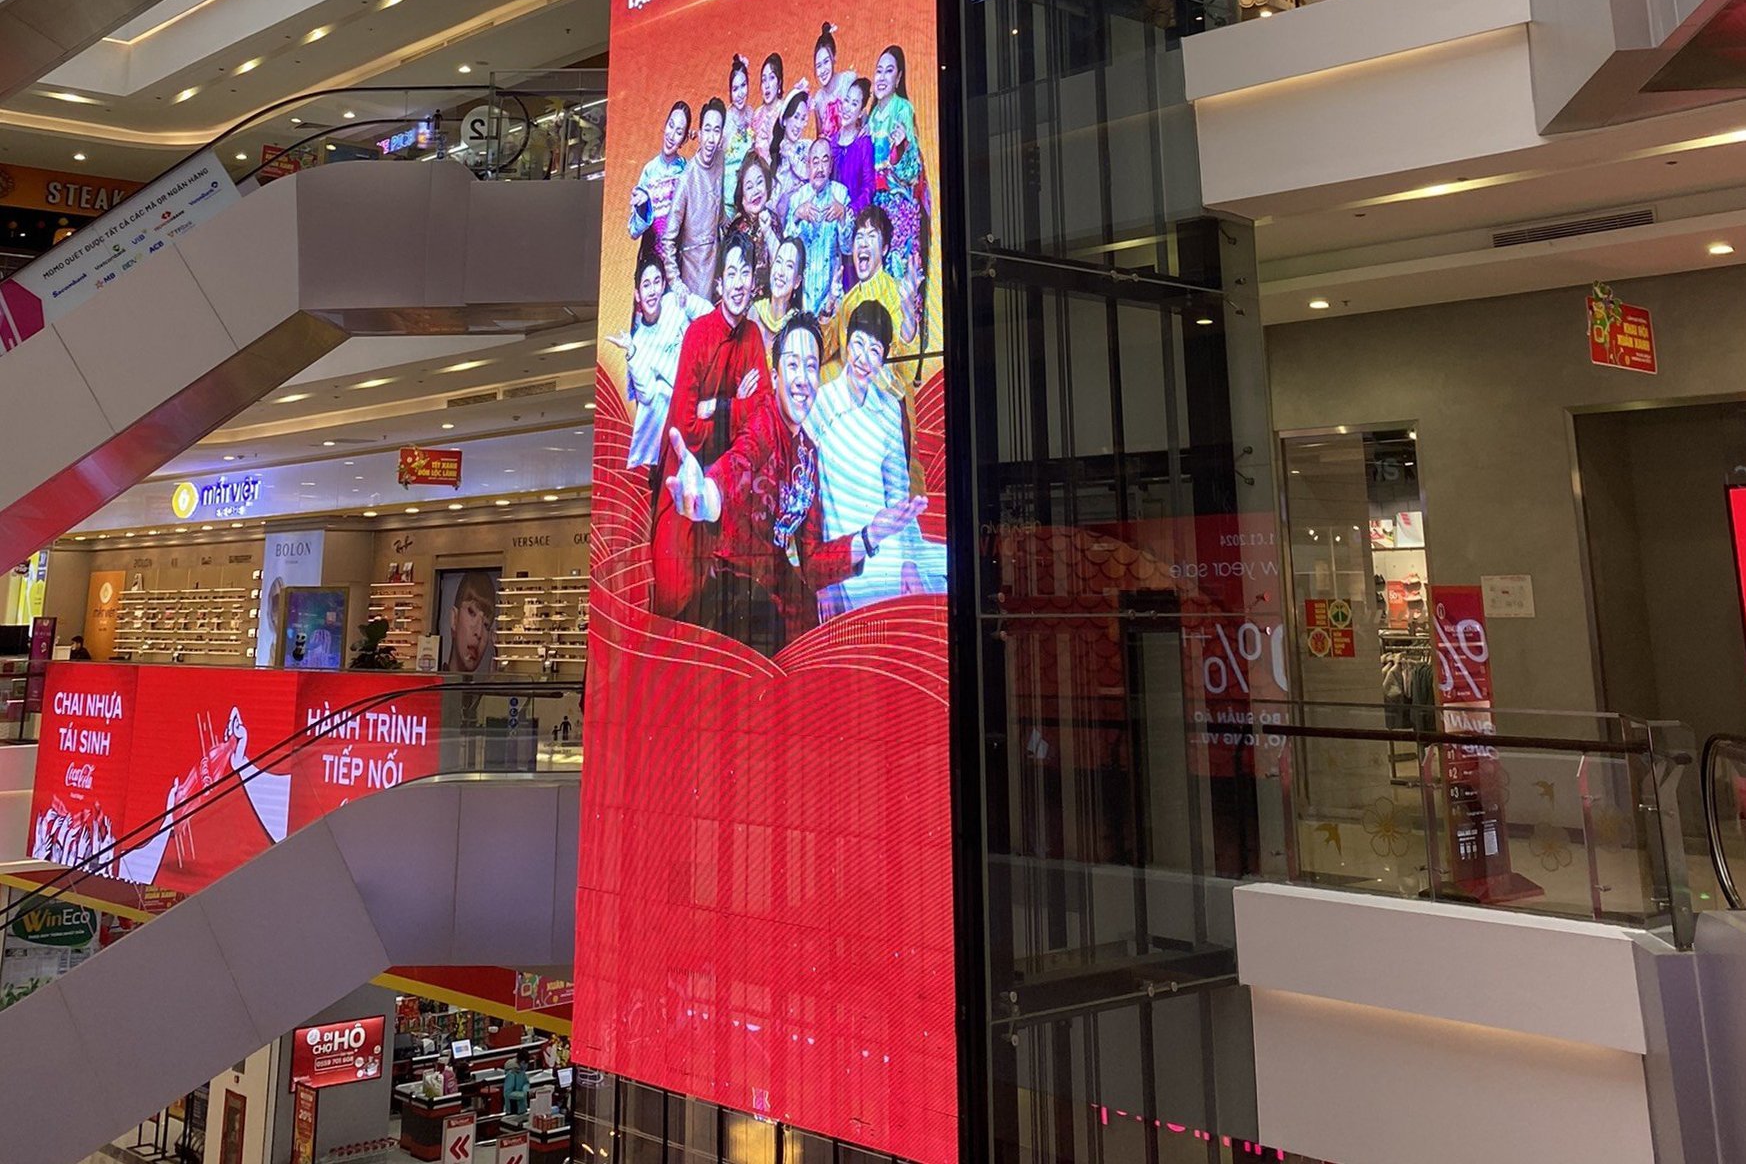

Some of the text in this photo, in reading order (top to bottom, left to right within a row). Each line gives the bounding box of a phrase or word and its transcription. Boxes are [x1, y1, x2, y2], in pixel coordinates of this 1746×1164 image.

[275, 541, 312, 557] BOLON
[512, 535, 550, 547] VERSACE
[54, 691, 123, 724] CHAI NHỰA
[306, 700, 427, 746] HÀNH TRÌNH
[59, 721, 111, 756] TÁI SINH
[322, 744, 403, 789] TIẾP NỐI
[23, 908, 91, 933] WinEco
[333, 1023, 366, 1053] HỘ
